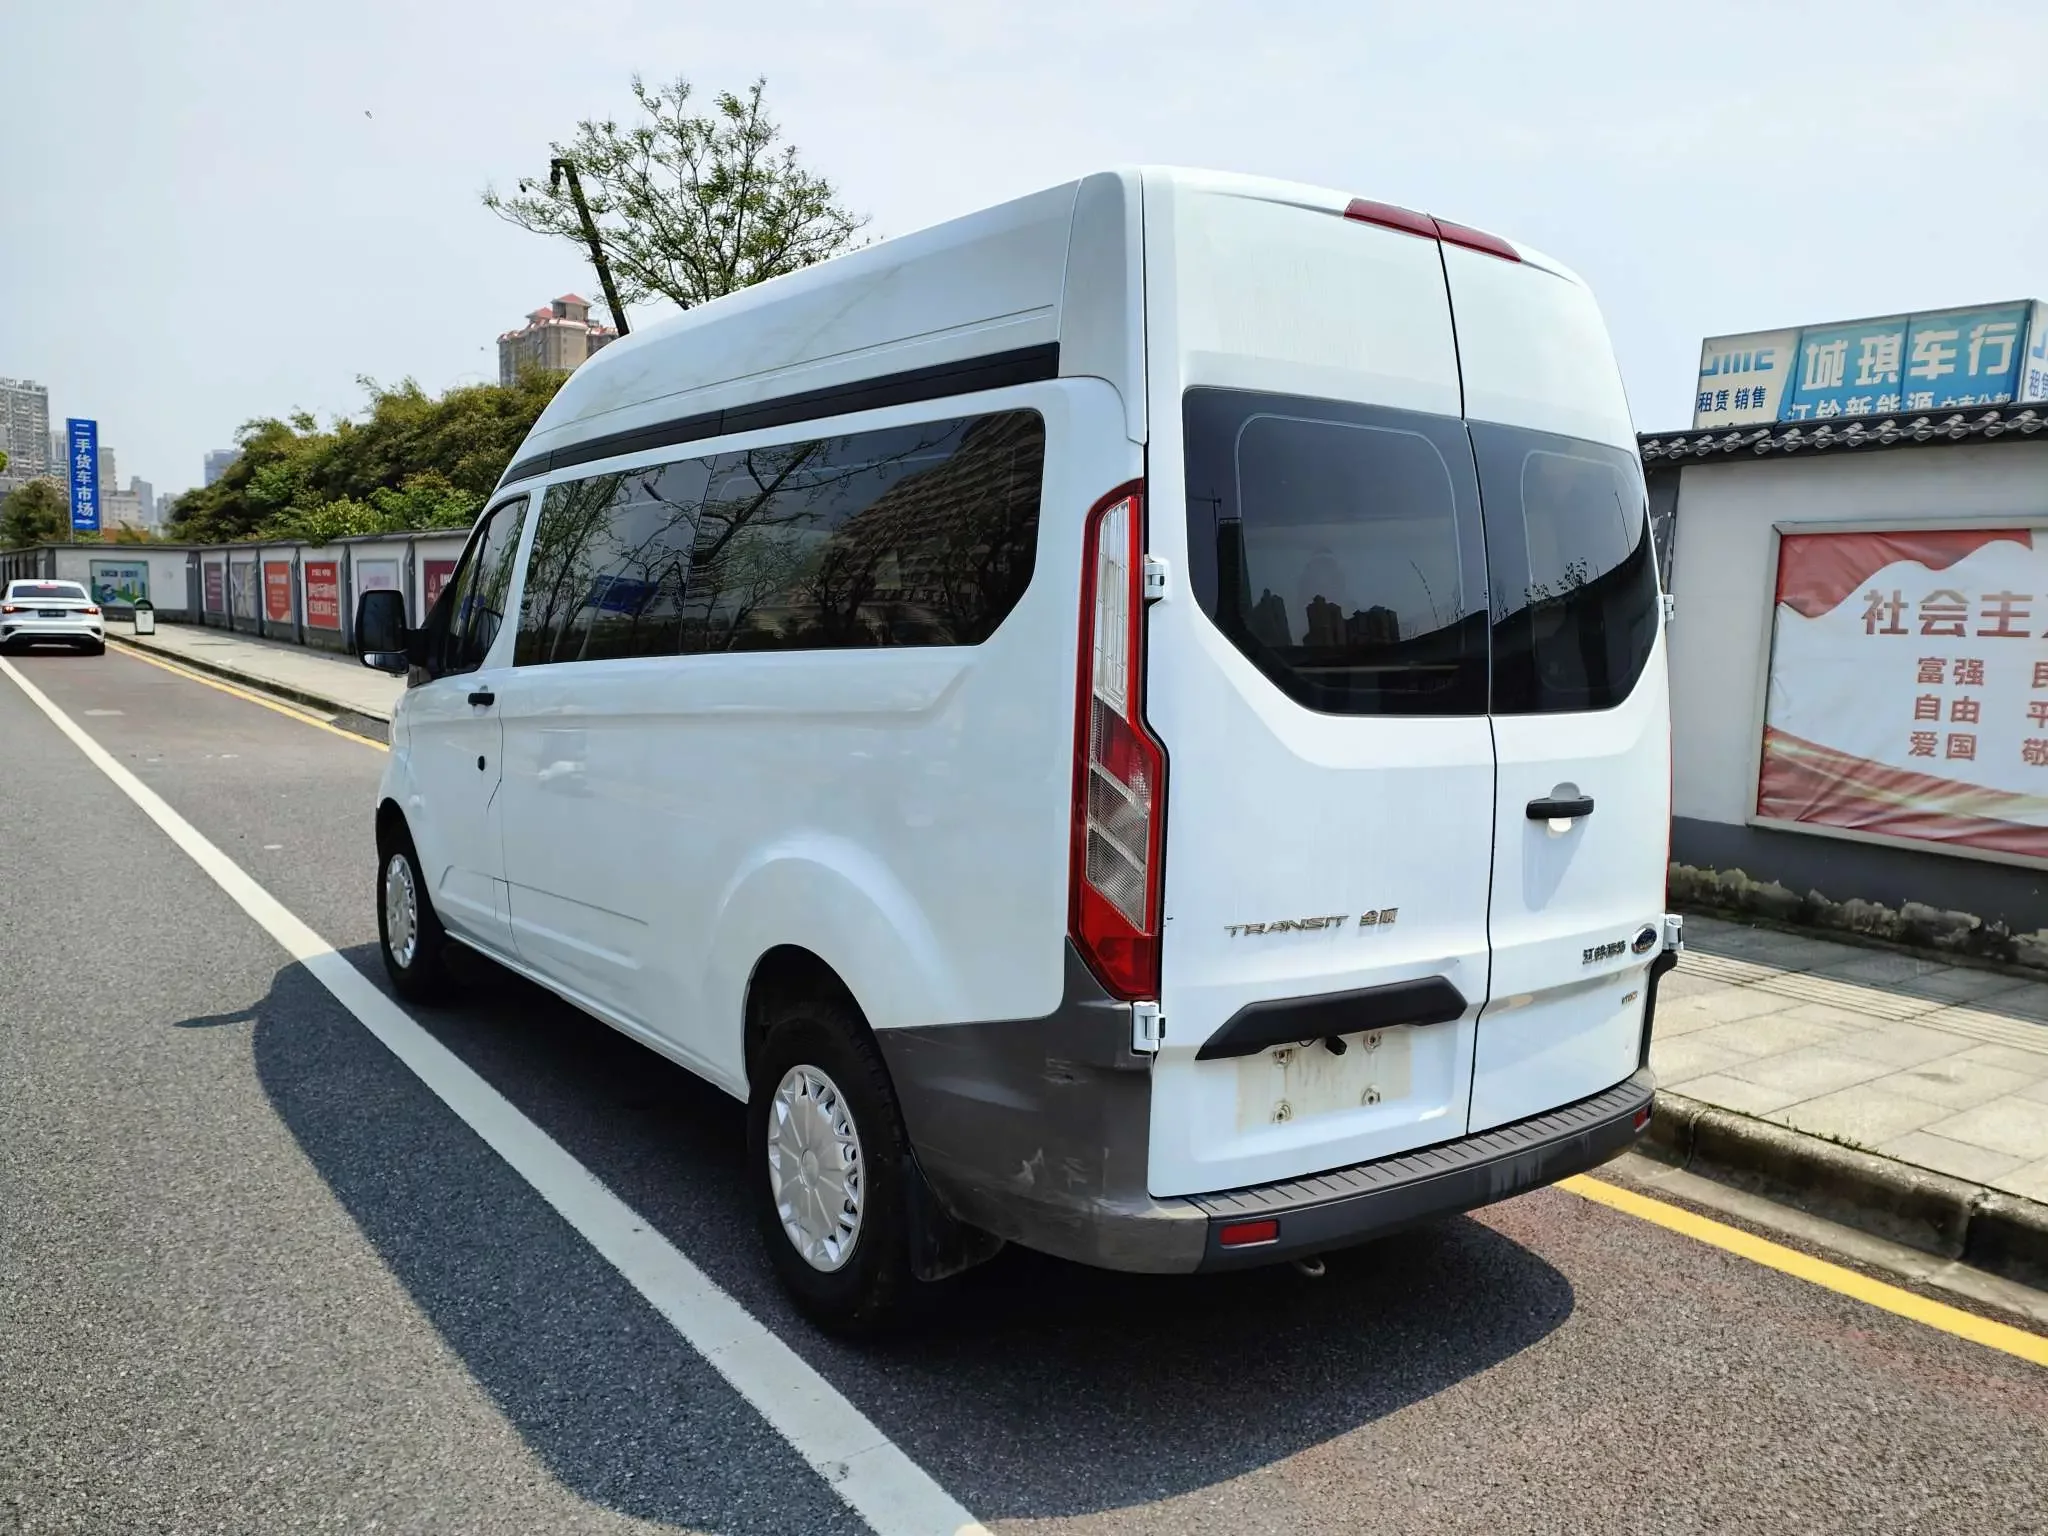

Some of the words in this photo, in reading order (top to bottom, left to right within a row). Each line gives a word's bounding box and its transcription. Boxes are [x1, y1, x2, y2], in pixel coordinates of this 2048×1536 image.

[1802, 322, 2017, 391] 城琪车行
[1697, 390, 1730, 413] 租赁
[1734, 386, 1767, 411] 销售
[74, 423, 94, 517] 二手货车市场
[1861, 590, 2048, 638] 社会主
[1917, 657, 1985, 687] 富强
[1914, 694, 1981, 724] 自由
[1908, 731, 1977, 761] 爱国
[1223, 915, 1350, 939] TRANSIT
